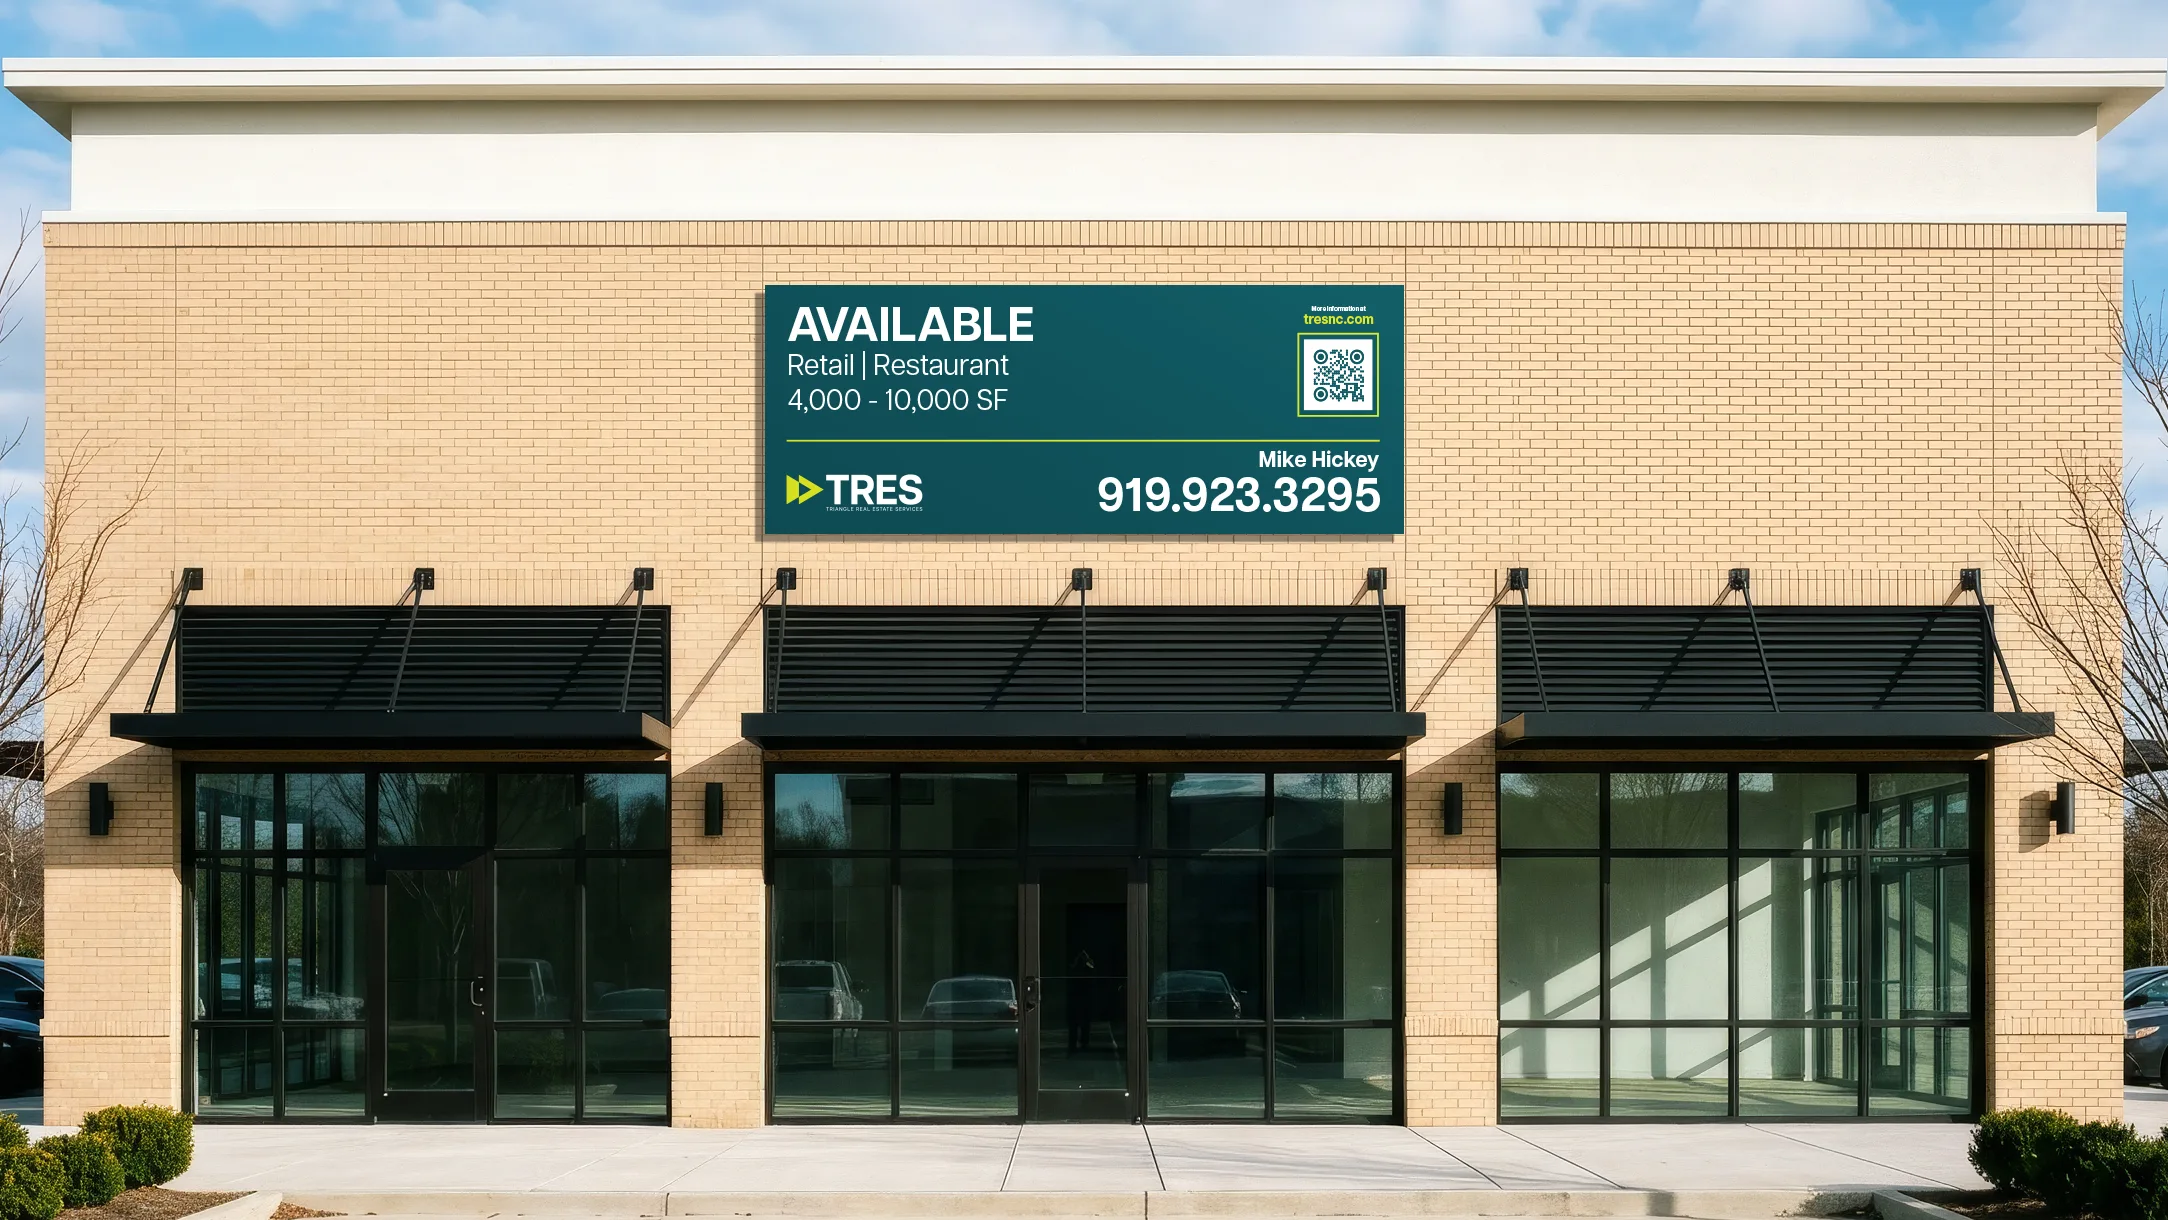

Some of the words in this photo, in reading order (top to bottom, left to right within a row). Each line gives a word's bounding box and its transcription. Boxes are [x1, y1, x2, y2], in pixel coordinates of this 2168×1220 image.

[787, 306, 1034, 342] AVAILABLE
[1303, 313, 1375, 325] tresnc.com
[788, 352, 854, 376] Retail
[874, 352, 1010, 376] Restaurant
[787, 388, 861, 413] 4,000
[885, 388, 969, 413] 10,000
[976, 388, 1009, 412] SF
[1259, 450, 1307, 468] Mike
[1312, 450, 1380, 473] Hickey
[826, 474, 924, 505] TRES
[1098, 476, 1381, 513] 919.923.3295
